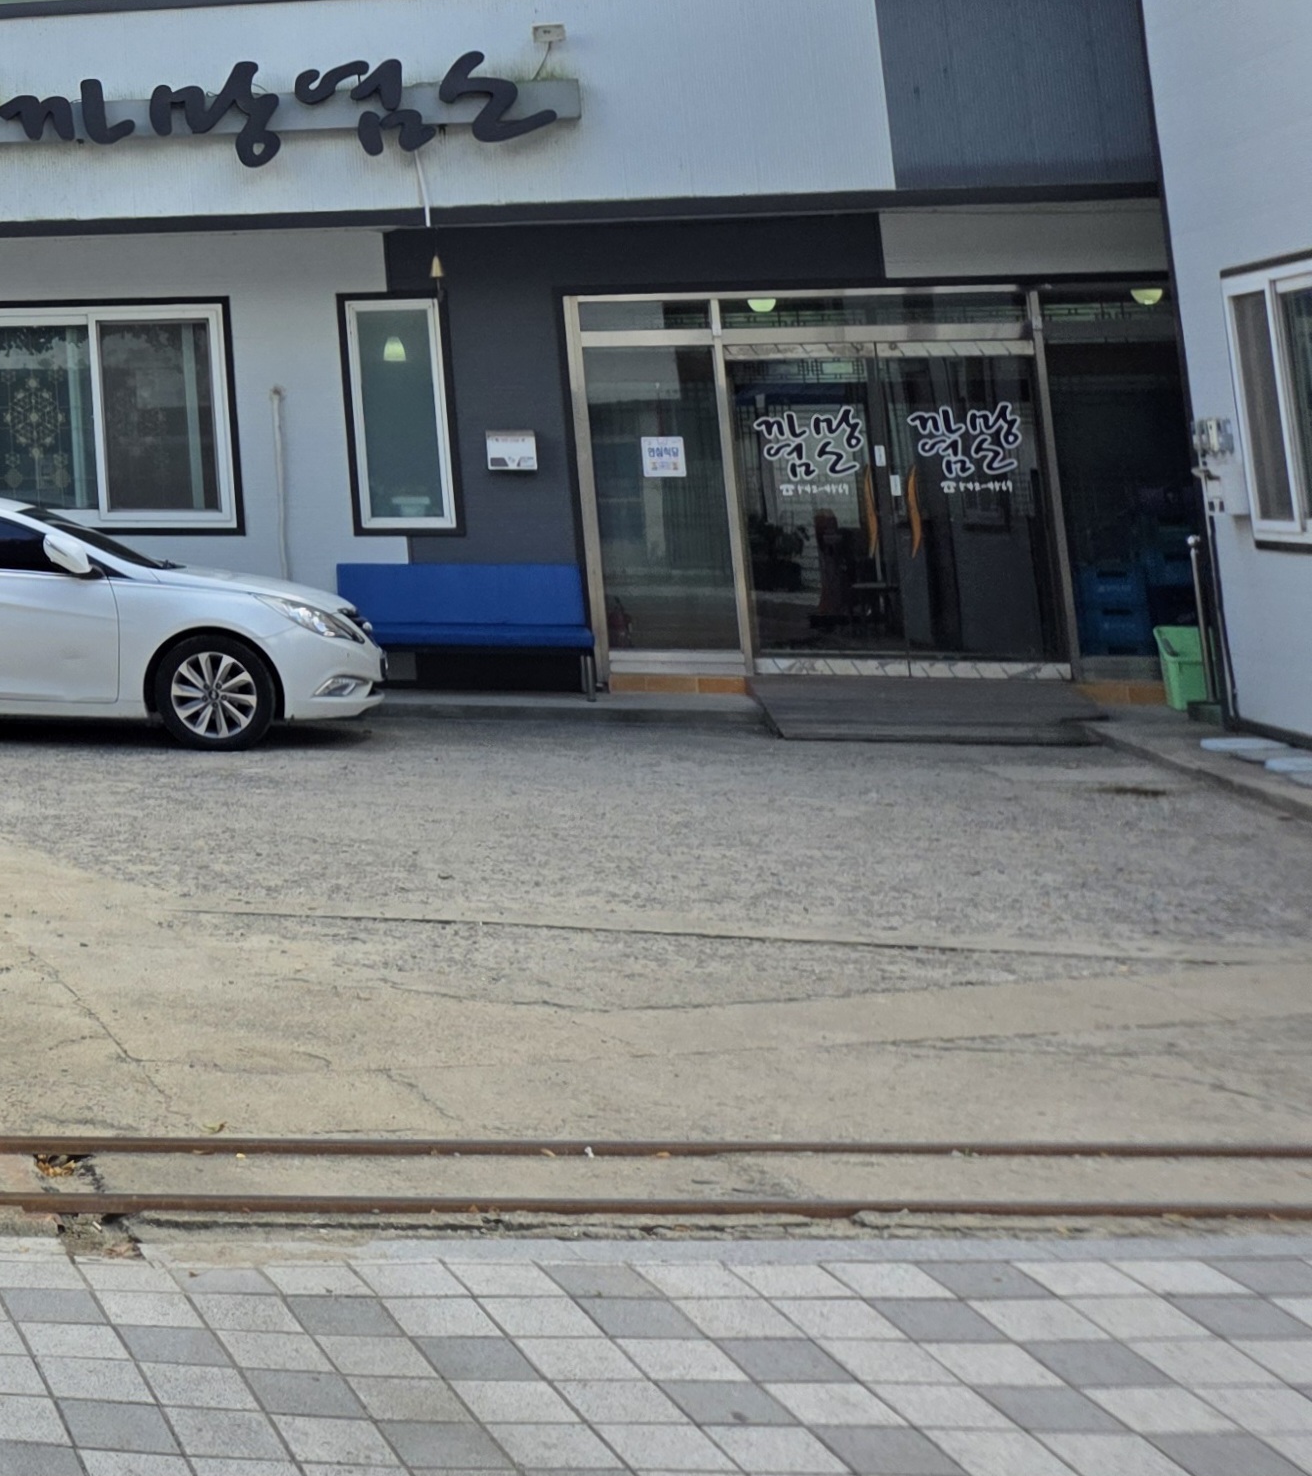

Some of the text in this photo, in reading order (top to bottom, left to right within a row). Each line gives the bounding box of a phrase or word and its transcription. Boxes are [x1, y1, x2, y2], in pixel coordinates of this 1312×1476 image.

[753, 406, 863, 451] 까망
[907, 402, 1021, 449] 까망
[764, 438, 860, 481] 염소
[918, 435, 1017, 478] 염소
